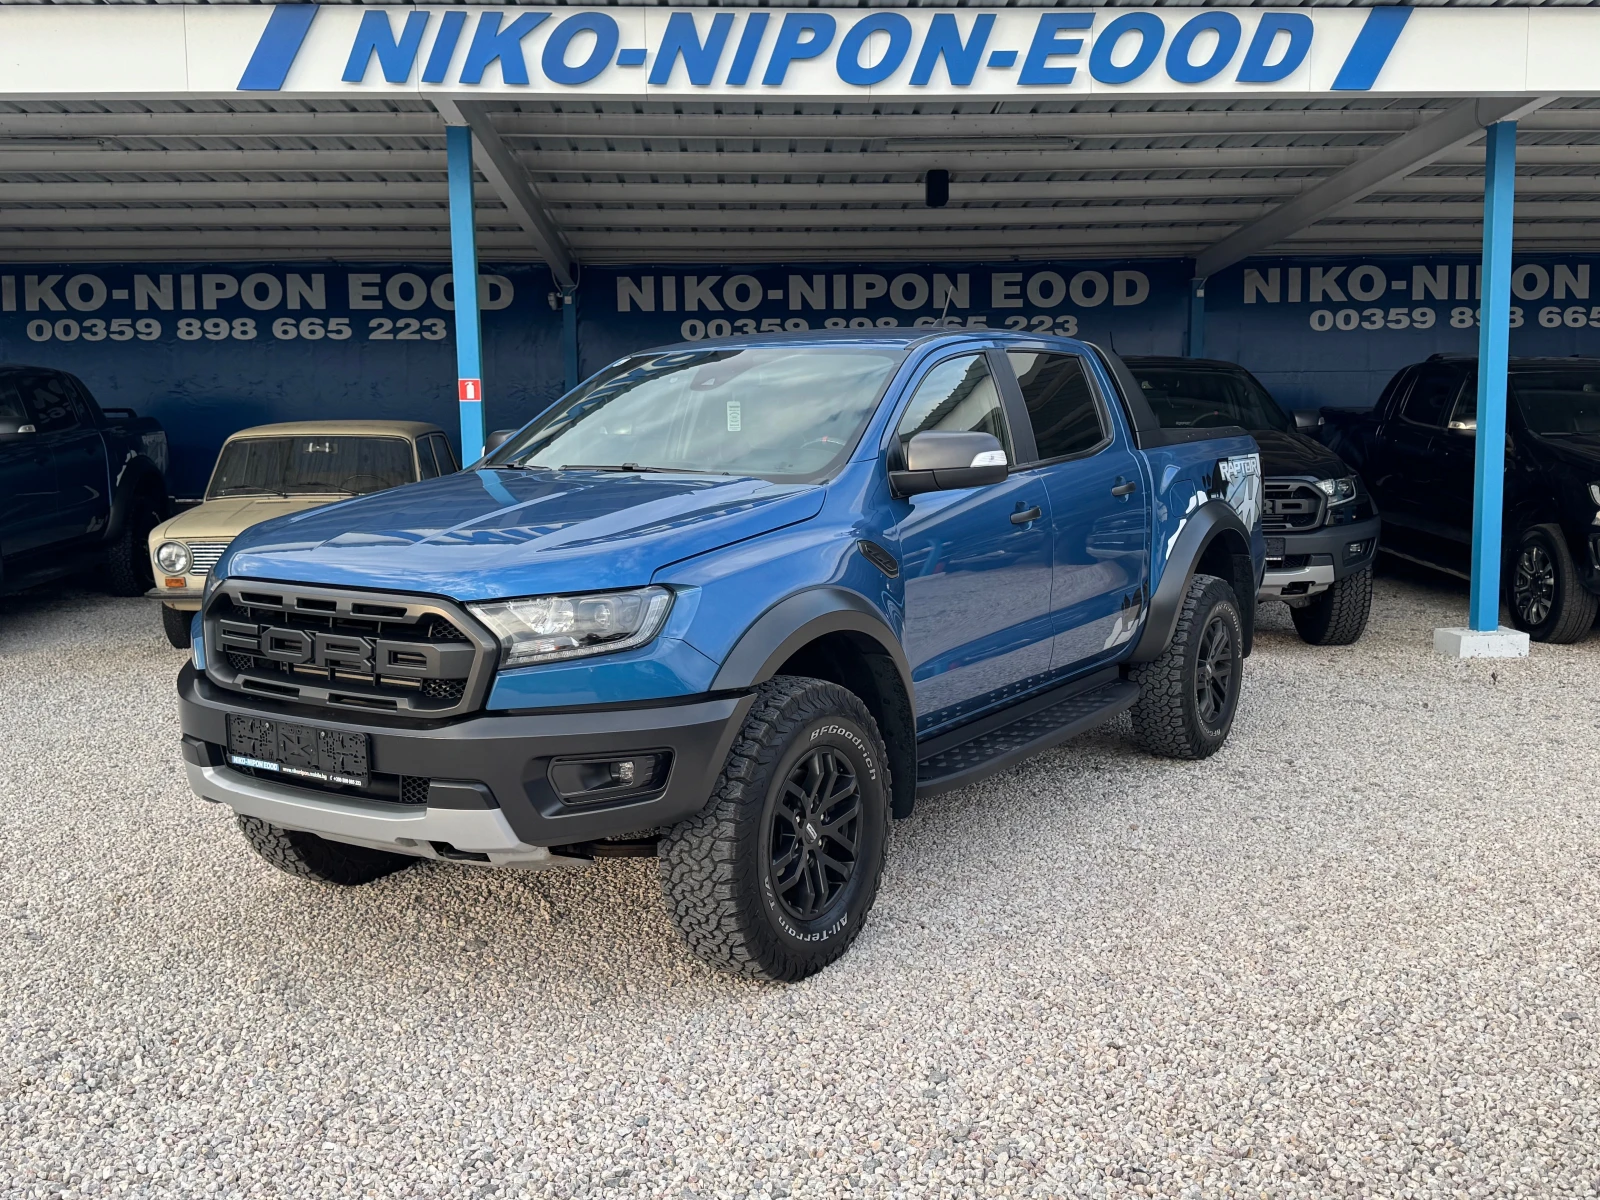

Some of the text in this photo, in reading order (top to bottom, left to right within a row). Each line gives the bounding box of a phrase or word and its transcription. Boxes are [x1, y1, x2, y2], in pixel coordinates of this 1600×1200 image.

[341, 10, 1314, 86] NIKO-NIPON-EOOD
[616, 270, 1150, 312] NIKO-NIPON EOOD
[1244, 264, 1590, 304] NIKO-NION
[26, 317, 447, 342] 00359 898 665 223
[681, 318, 810, 341] 00359
[1004, 315, 1078, 337] 223
[1309, 307, 1437, 331] 00359
[1450, 306, 1524, 328] 88
[1219, 457, 1260, 482] RAPTOR
[216, 619, 476, 679] FORD
[810, 725, 876, 780] BFGoodrich
[778, 912, 848, 941] All-Terrain
